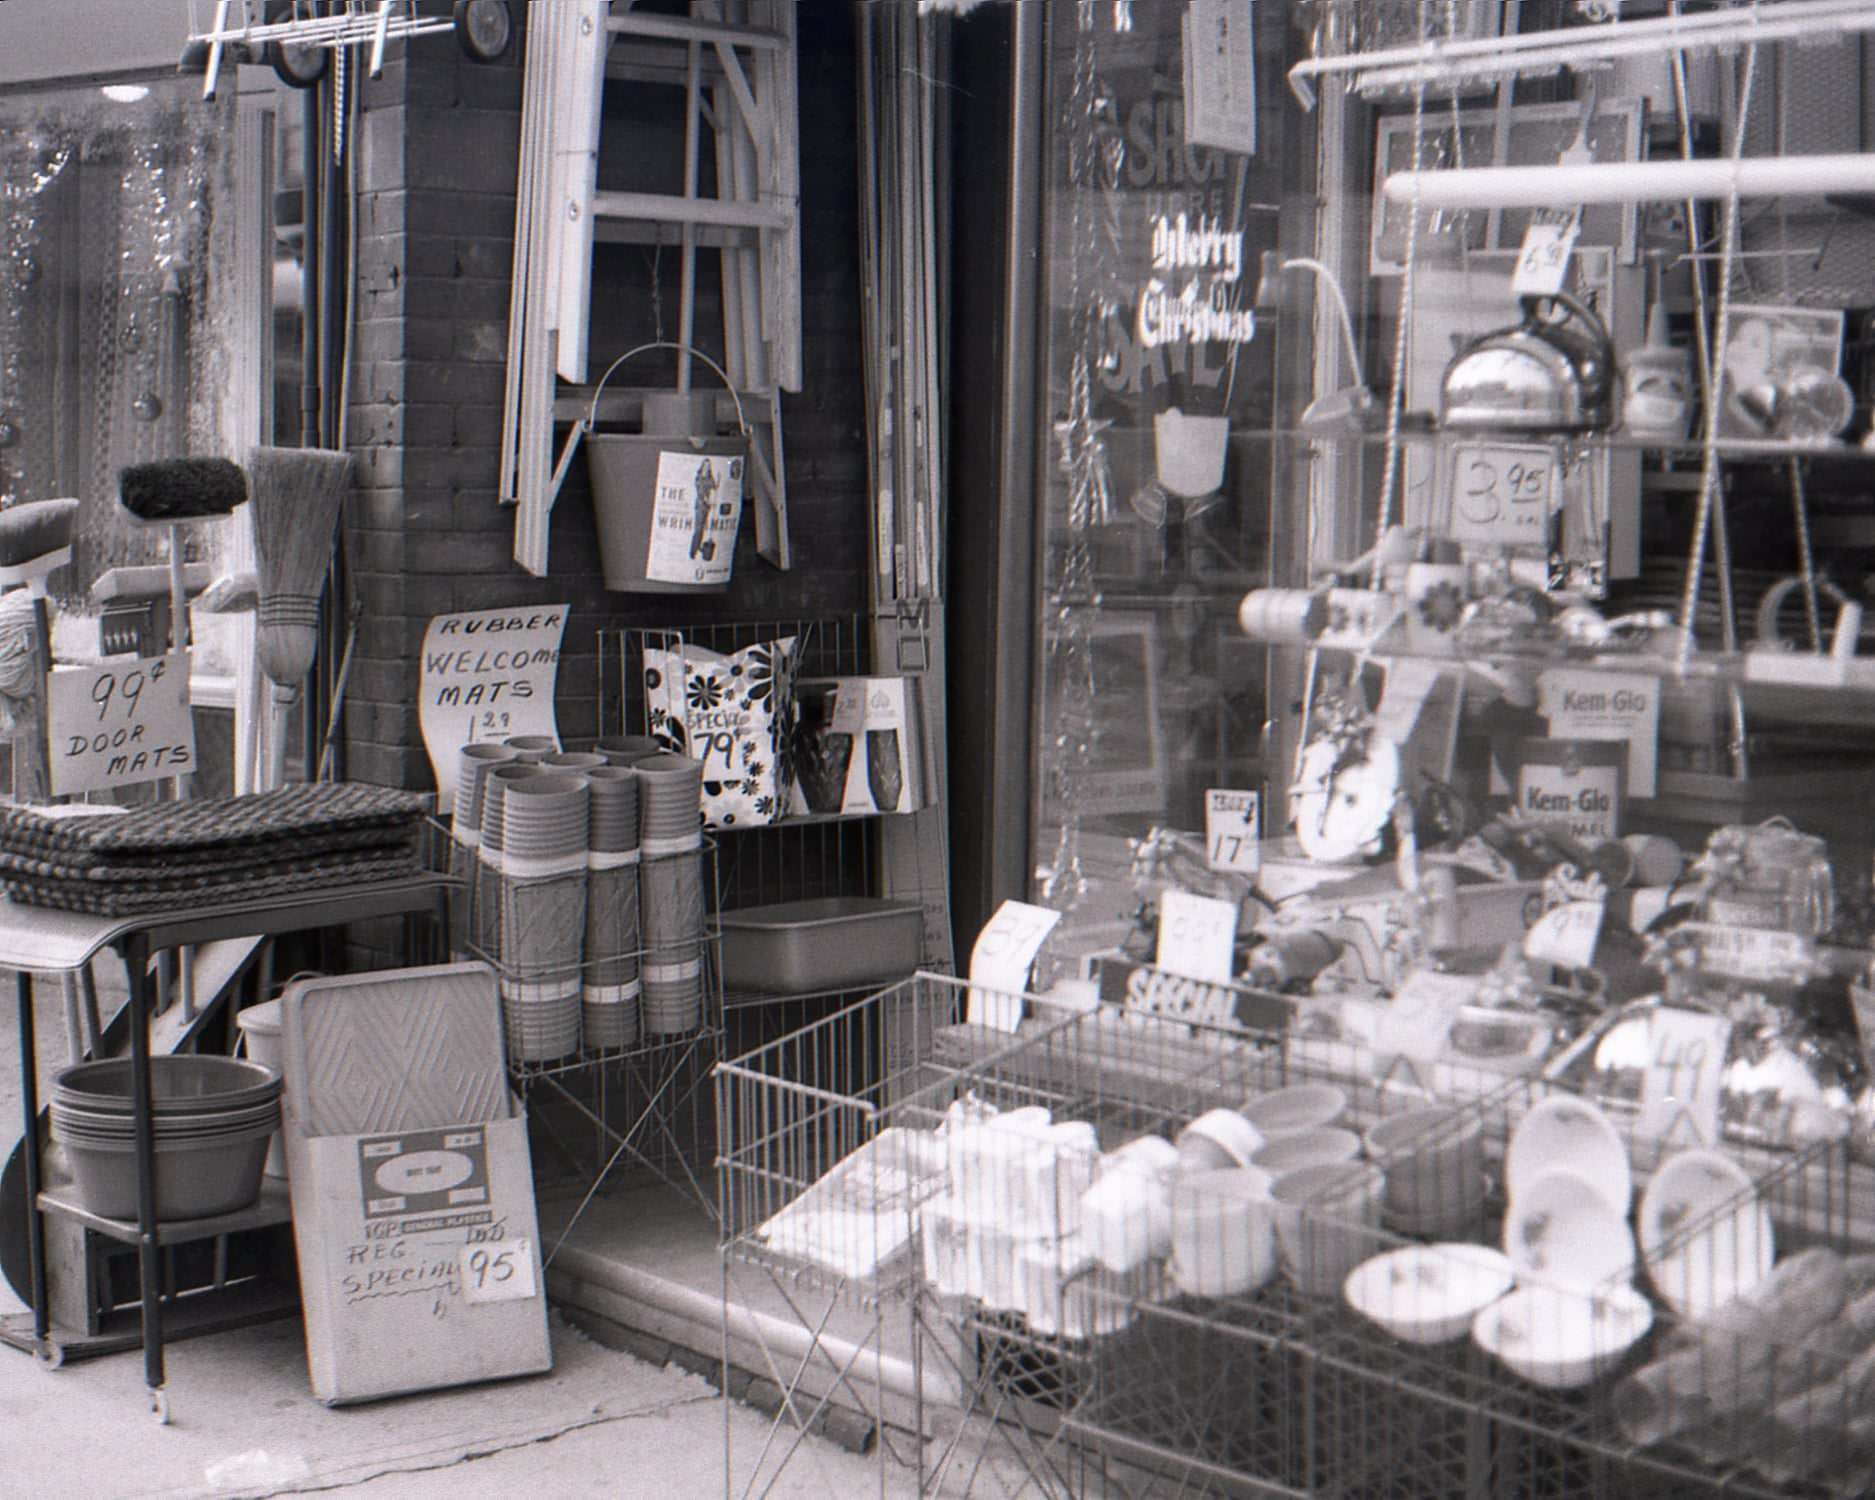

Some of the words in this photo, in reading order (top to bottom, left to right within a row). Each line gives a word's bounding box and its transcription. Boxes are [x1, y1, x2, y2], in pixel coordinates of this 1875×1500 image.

[1151, 211, 1246, 282] Merry
[1139, 275, 1256, 348] Christmas
[661, 487, 685, 501] THE
[440, 613, 561, 635] RUBBER
[437, 680, 534, 706] MATS
[65, 724, 146, 757] DOOR
[106, 745, 190, 776] MATS
[1527, 785, 1611, 812] Kem-Glo
[1655, 1032, 1708, 1101] 49
